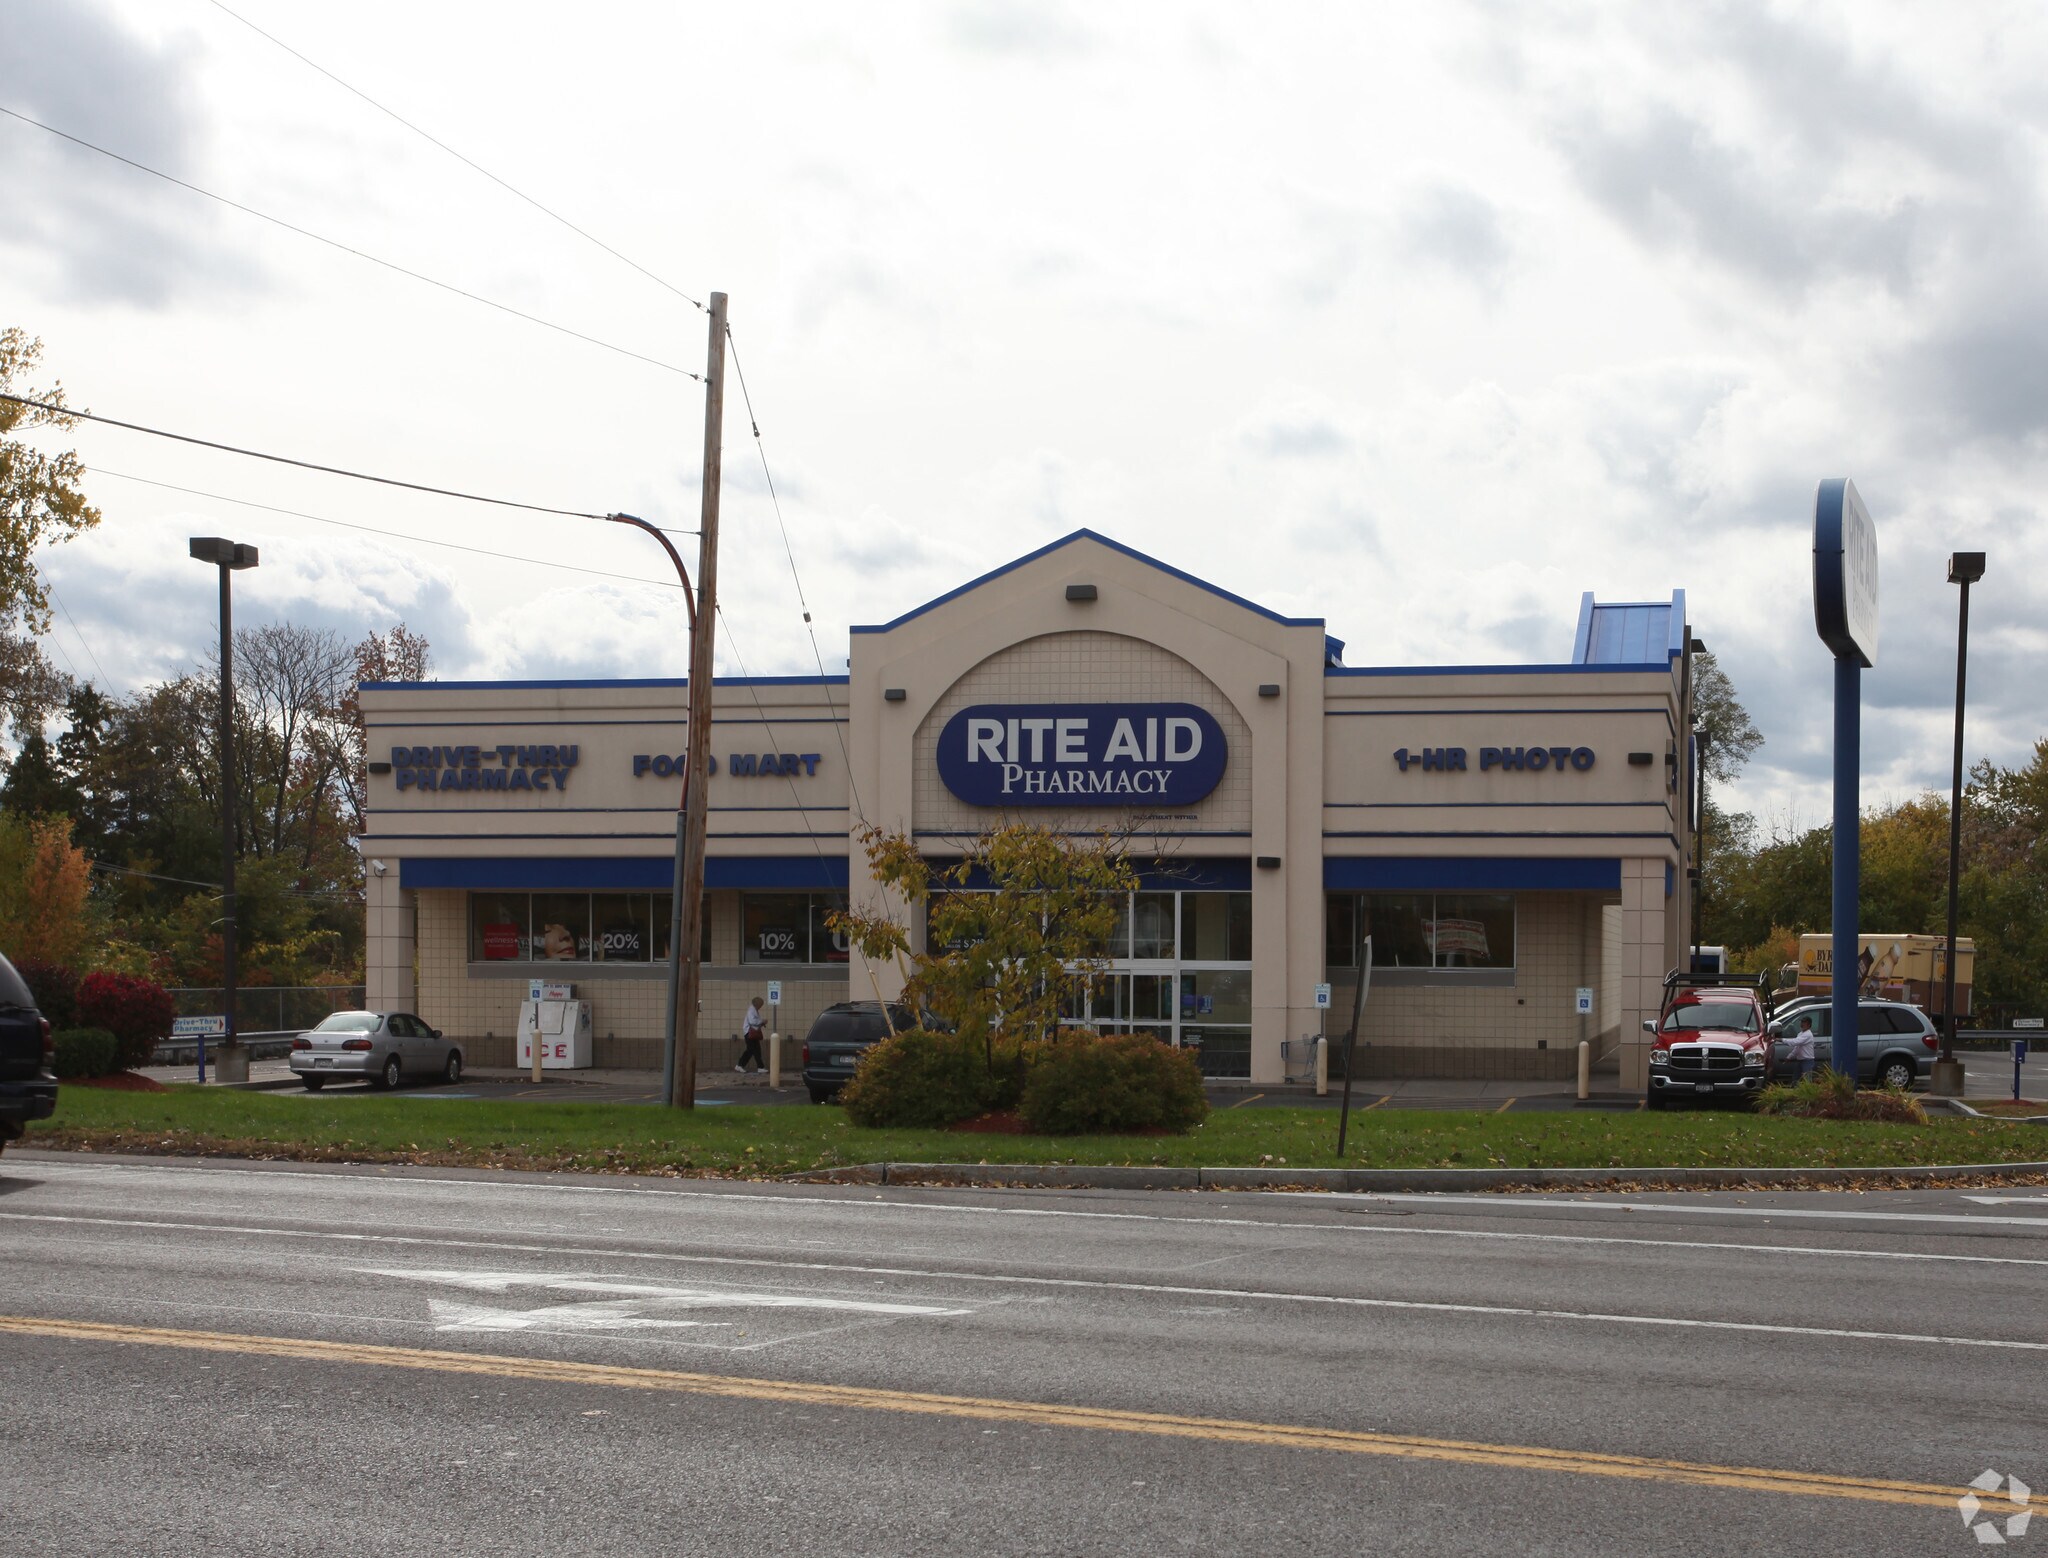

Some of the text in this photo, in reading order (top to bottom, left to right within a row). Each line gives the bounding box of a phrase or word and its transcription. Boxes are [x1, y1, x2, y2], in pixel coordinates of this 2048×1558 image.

[967, 717, 1203, 763] RITE AID
[391, 744, 580, 768] DRIVE-THRU
[729, 753, 822, 777] MART
[1393, 747, 1596, 771] 1-HR PHOTO
[395, 768, 572, 791] PHARMACY
[1001, 763, 1172, 794] PHARMACY
[604, 933, 640, 949] 20%
[758, 933, 795, 950] 10%
[175, 1025, 213, 1033] Pharmacy
[525, 1044, 567, 1058] ICE
